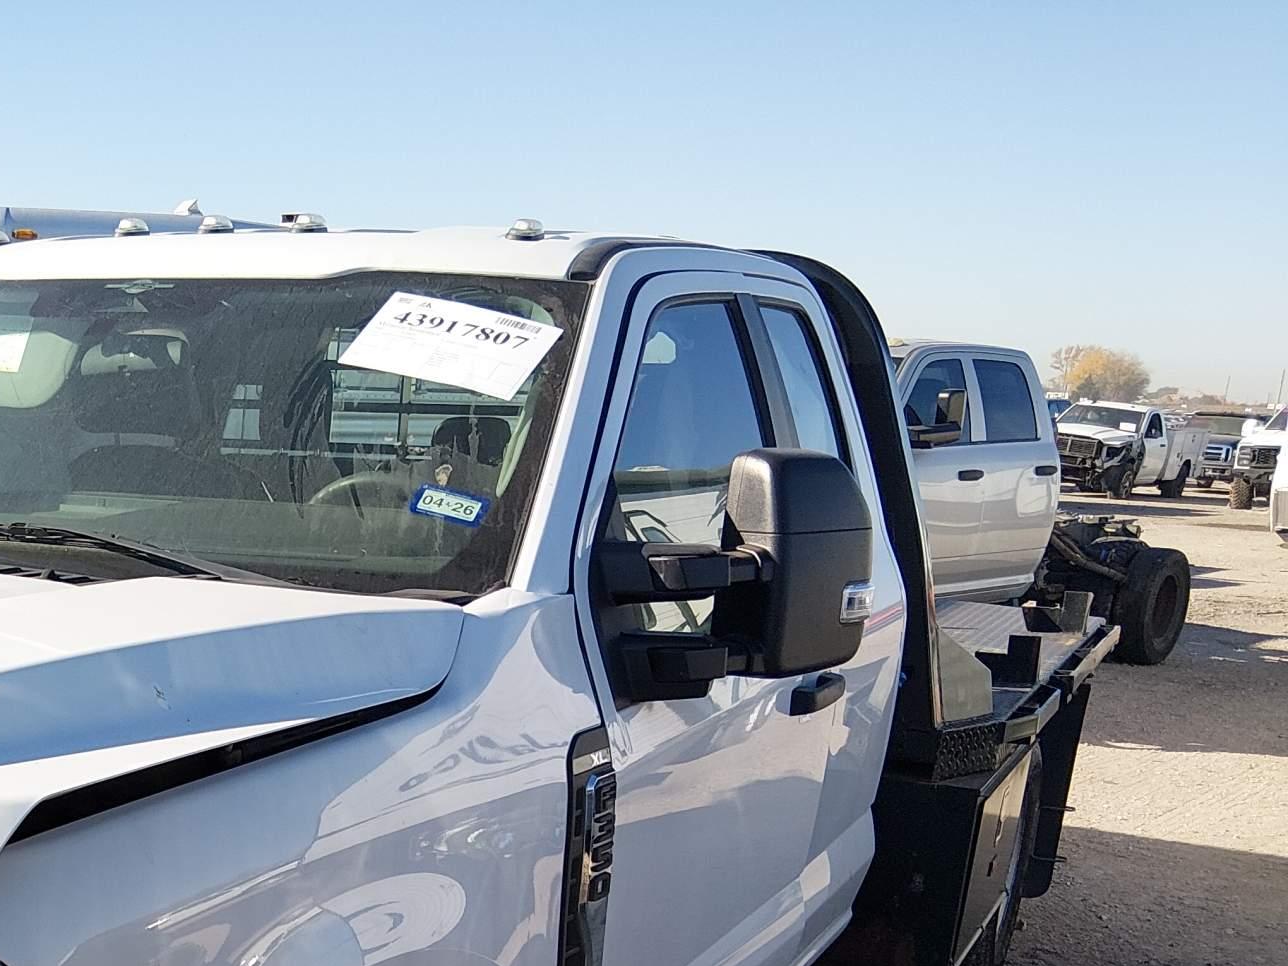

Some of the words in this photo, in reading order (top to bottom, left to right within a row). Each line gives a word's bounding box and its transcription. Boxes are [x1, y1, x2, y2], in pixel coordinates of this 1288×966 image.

[393, 311, 530, 349] 43917807
[422, 495, 445, 508] 04
[451, 502, 475, 516] 26
[590, 752, 609, 767] XL
